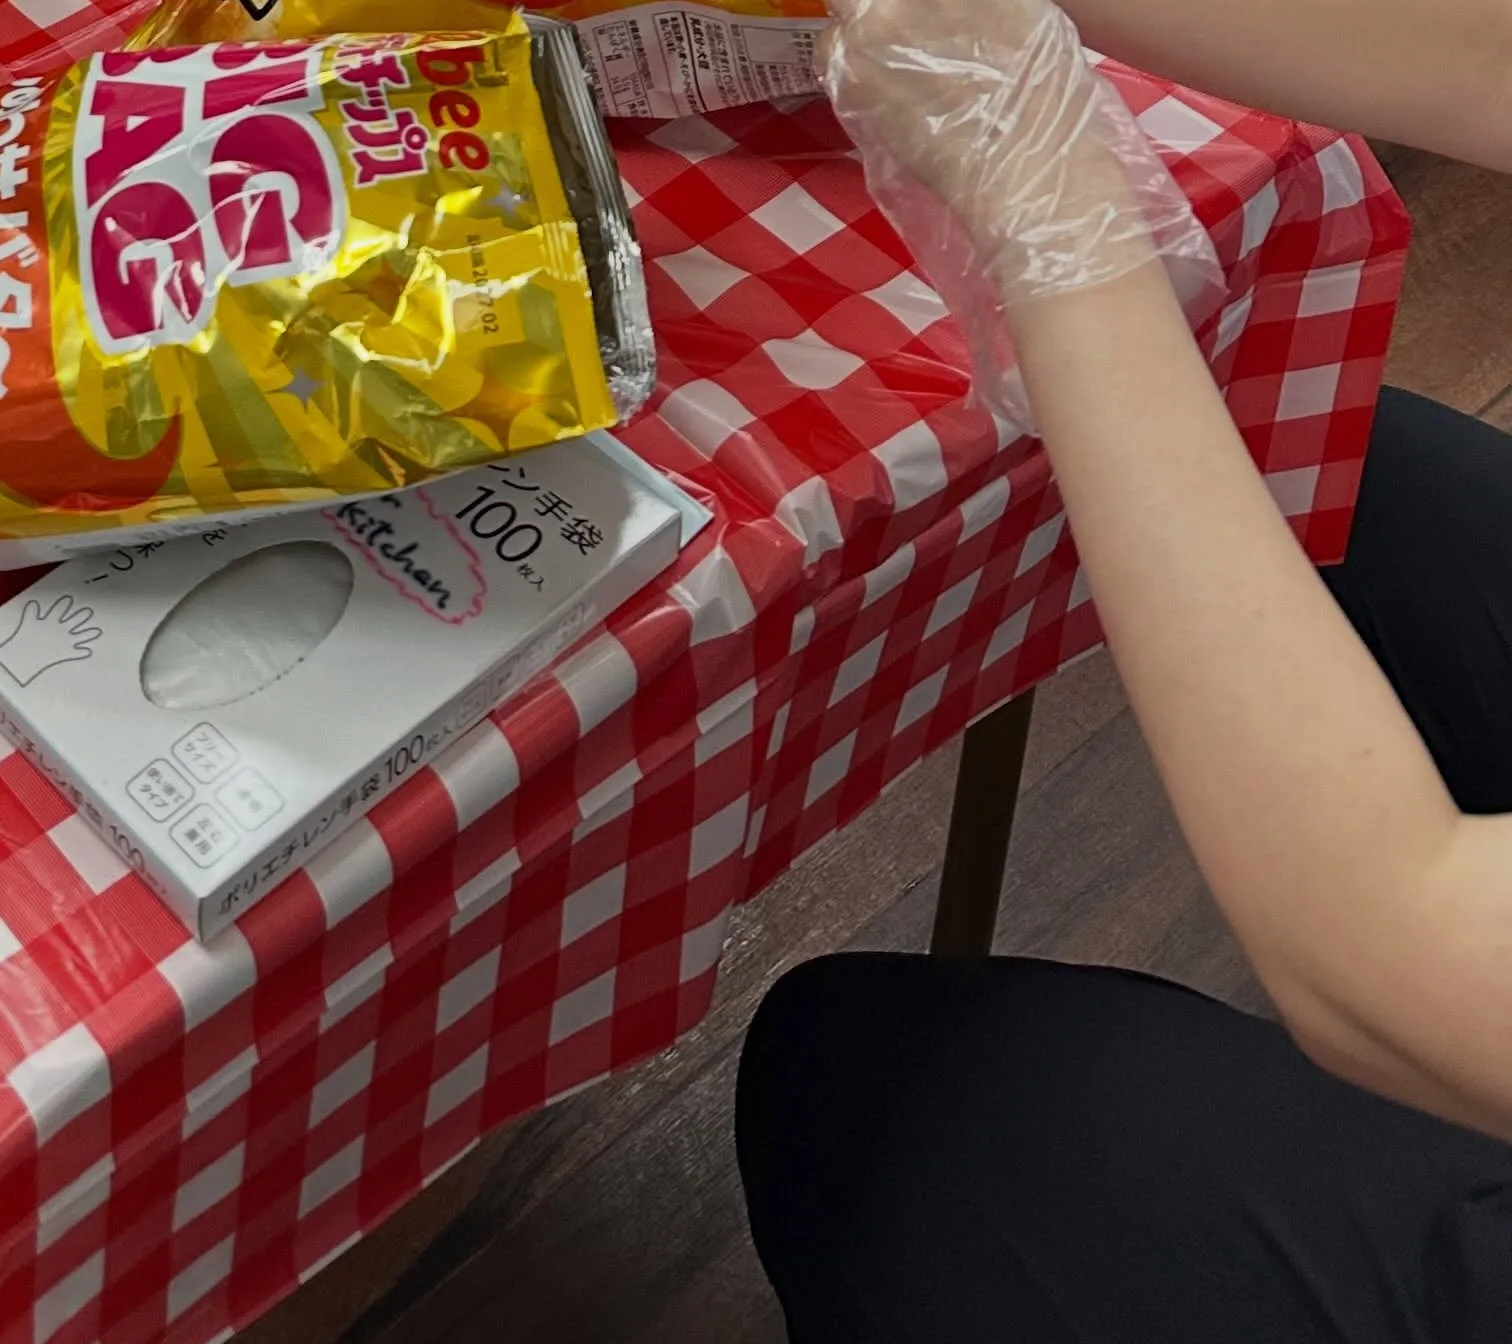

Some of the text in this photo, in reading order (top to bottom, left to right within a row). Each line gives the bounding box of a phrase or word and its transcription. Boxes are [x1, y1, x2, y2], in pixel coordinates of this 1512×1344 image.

[415, 40, 490, 173] bee
[455, 485, 543, 562] 100
[382, 734, 426, 785] 100
